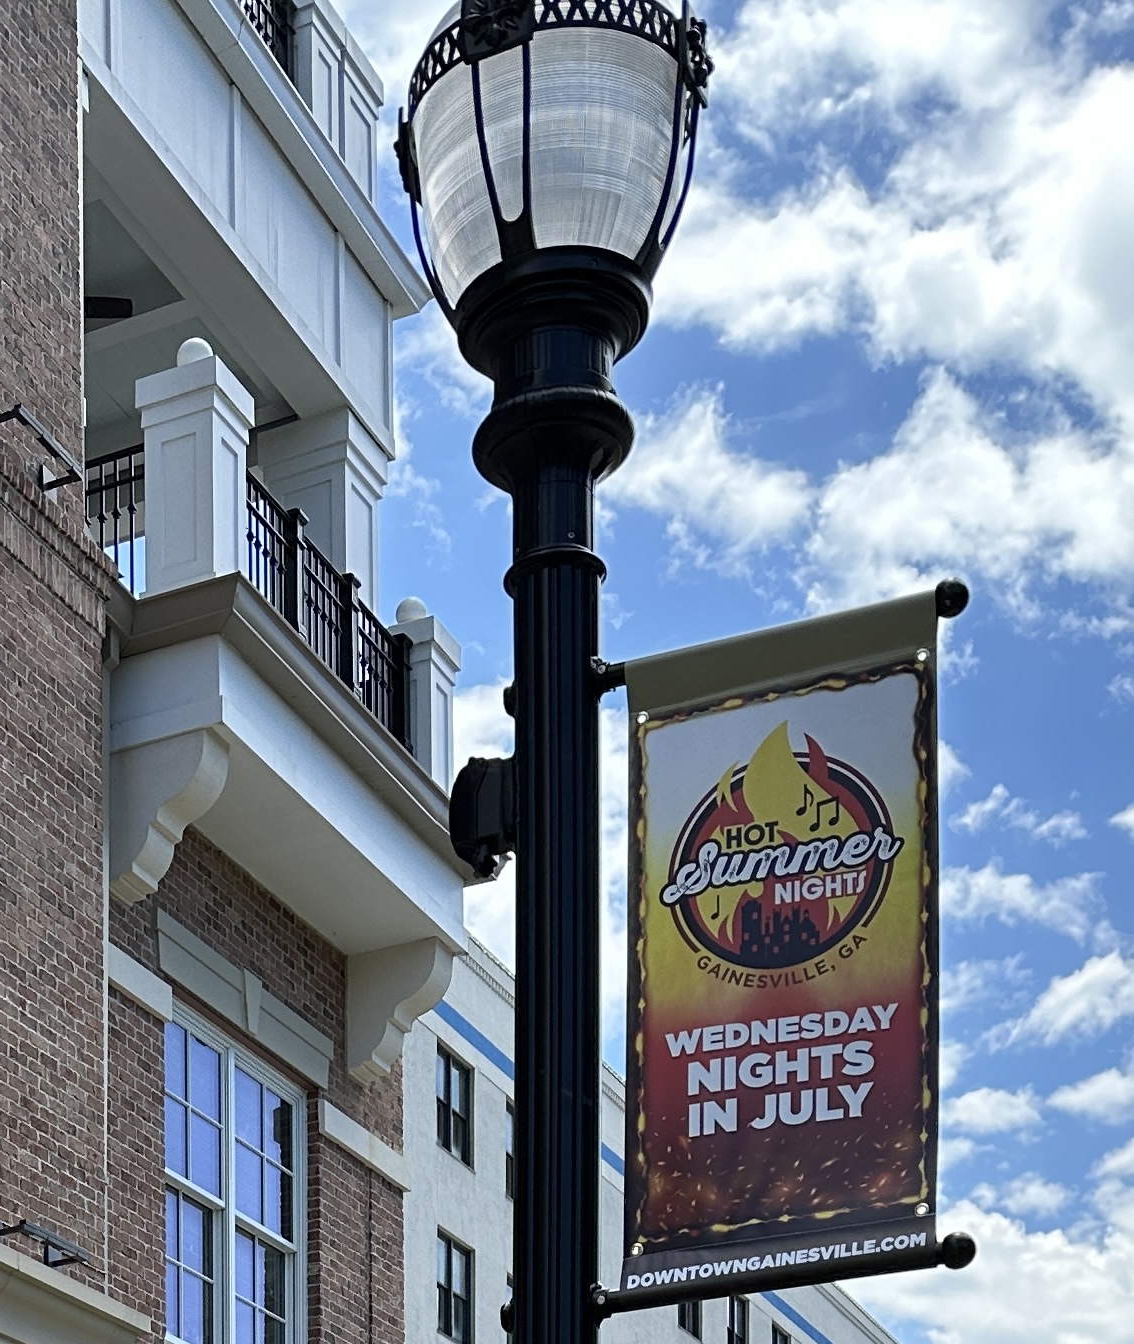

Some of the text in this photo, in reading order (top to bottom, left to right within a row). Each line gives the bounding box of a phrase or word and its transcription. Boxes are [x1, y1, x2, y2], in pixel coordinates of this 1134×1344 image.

[726, 821, 779, 849] HOT
[662, 826, 903, 905] Summer
[774, 870, 867, 905] NIGHTS
[697, 934, 868, 989] GAINESVILLE, GA
[665, 1003, 899, 1057] WEDNESDAY
[687, 1040, 875, 1096] NIGHTS
[688, 1081, 875, 1138] IN JULY
[627, 1233, 927, 1290] DOWNTOWNGAINESVILLE.COM
